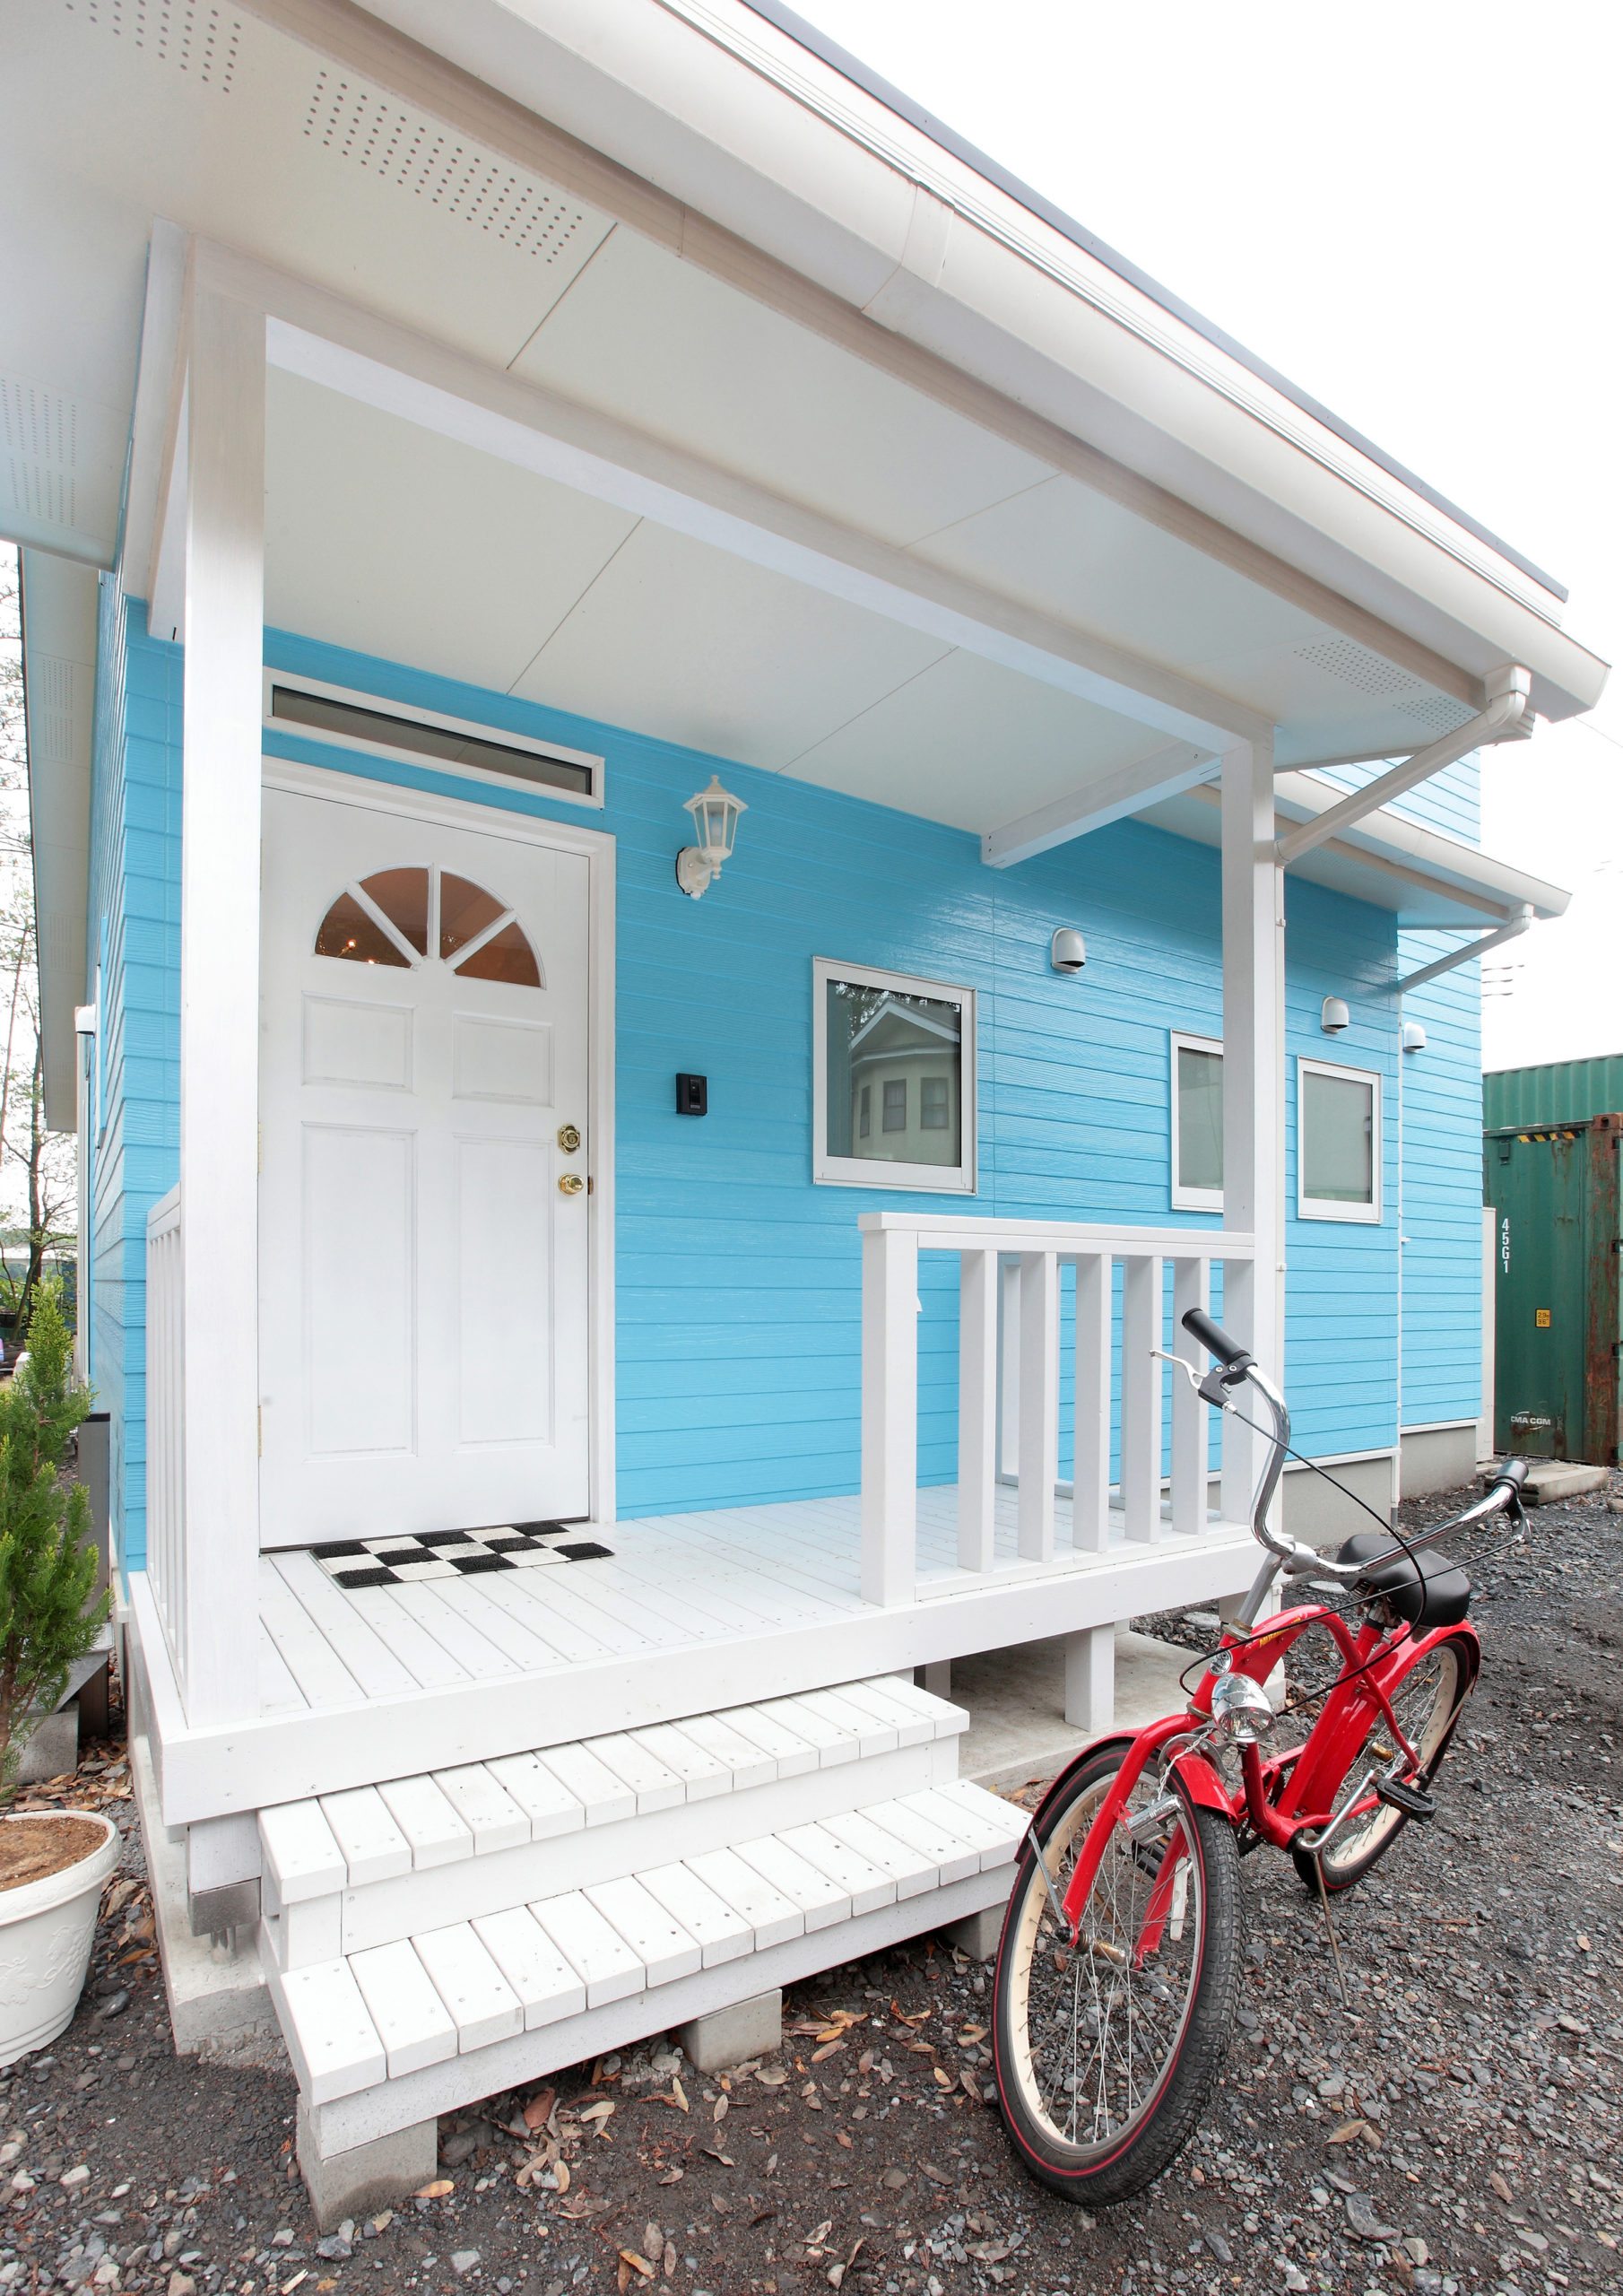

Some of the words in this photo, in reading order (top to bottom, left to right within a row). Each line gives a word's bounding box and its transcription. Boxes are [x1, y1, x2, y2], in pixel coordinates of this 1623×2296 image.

[1501, 1218, 1510, 1274] 45G1
[1510, 1415, 1529, 1424] CMA
[1529, 1417, 1551, 1426] CGM
